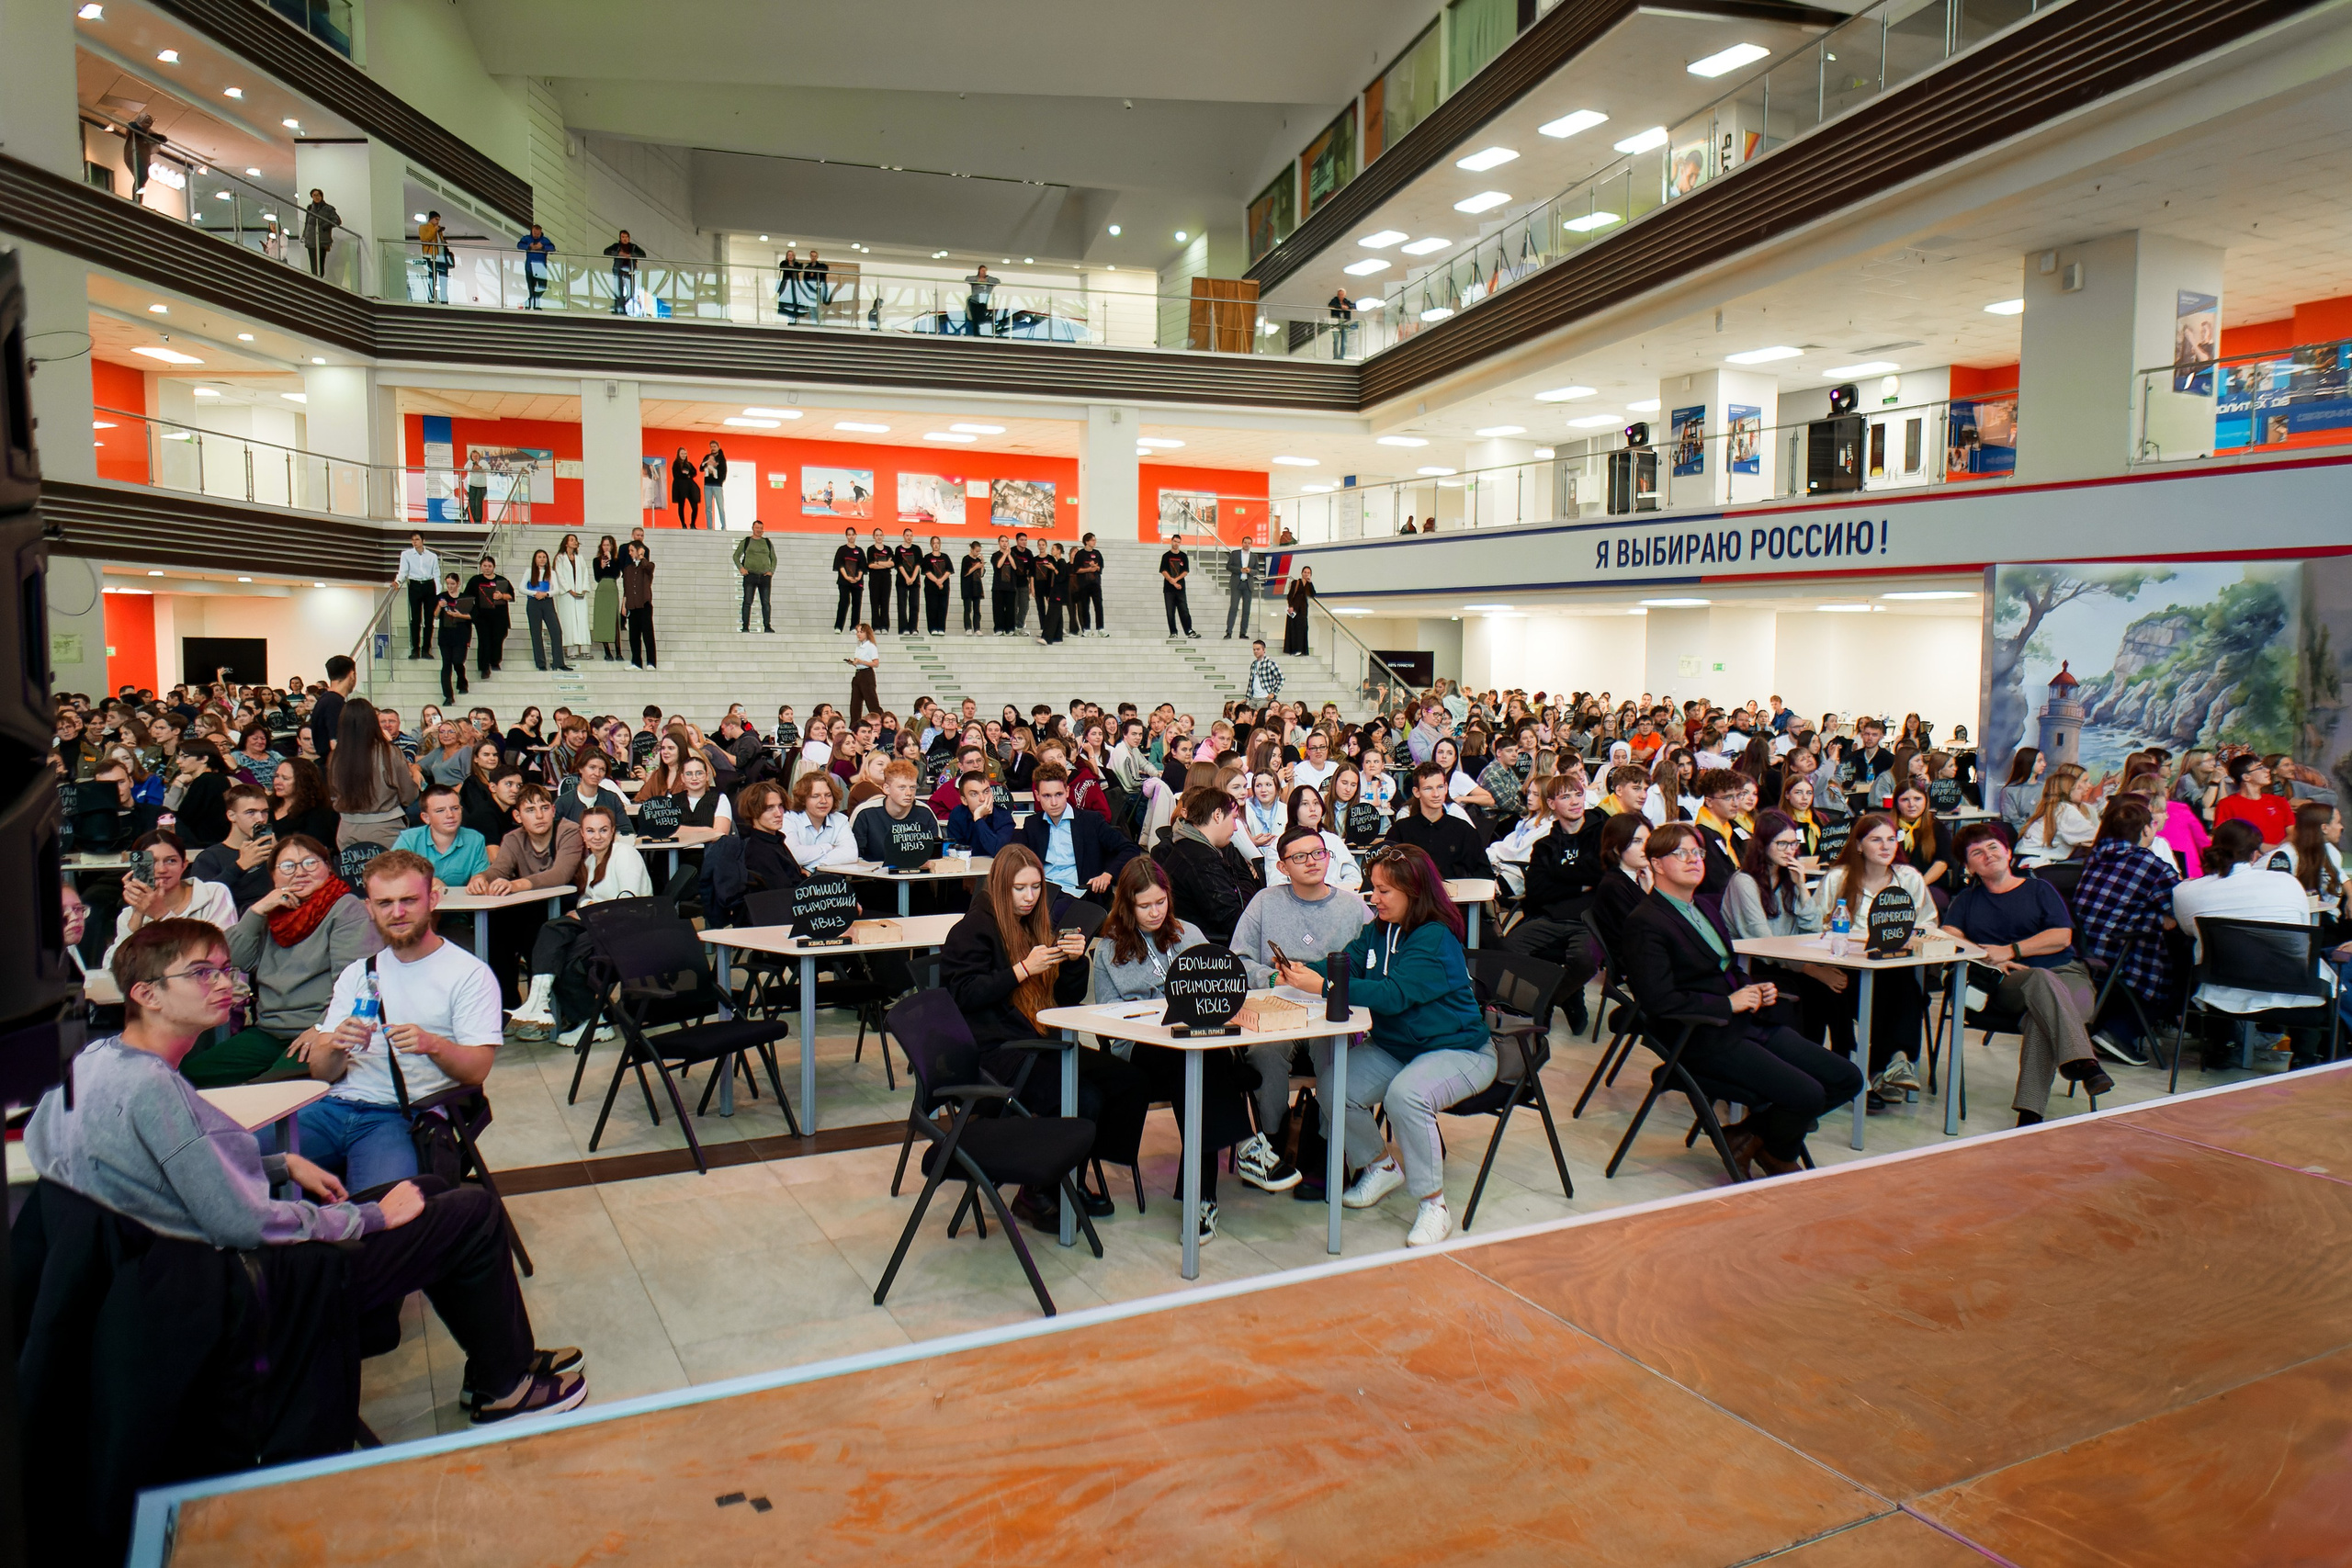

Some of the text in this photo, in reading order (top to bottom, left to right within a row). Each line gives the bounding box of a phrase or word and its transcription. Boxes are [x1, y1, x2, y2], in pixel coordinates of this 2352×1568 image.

[1596, 519, 1888, 569] Я ВЫБИРАЮ РОССИЮ!
[655, 817, 679, 826] КВИЗ
[891, 821, 921, 834] БОЛЬШОЙ
[1357, 823, 1373, 832] КВИЗ
[893, 830, 933, 844] ПРИМОРСКИЙ
[900, 840, 925, 852] КВИЗ
[795, 878, 847, 900] БОЛЬШОЙ
[792, 892, 856, 917] ПРИМОРСКИЙ
[810, 916, 846, 931] КВИЗ
[1882, 926, 1905, 942] КВИЗ
[1178, 953, 1232, 972] БОЛЬШОЙ
[1170, 974, 1247, 996] ПРИМОРСКИЙ
[1195, 997, 1231, 1016] КВИЗ
